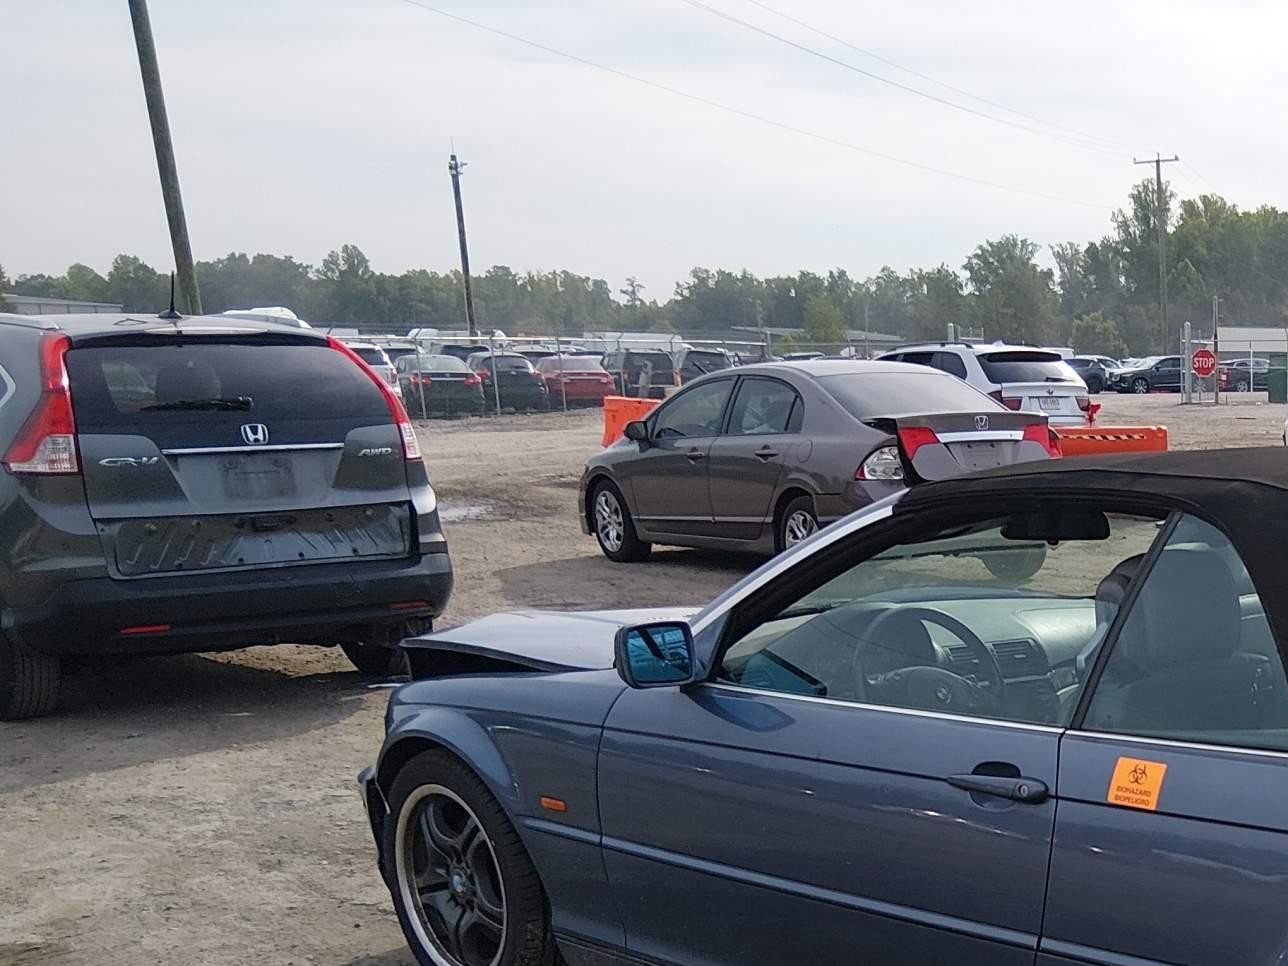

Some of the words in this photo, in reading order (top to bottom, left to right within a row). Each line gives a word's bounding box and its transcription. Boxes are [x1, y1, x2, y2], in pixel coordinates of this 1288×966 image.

[1193, 357, 1215, 369] STOP
[358, 447, 393, 457] AWD
[1116, 785, 1152, 797] BIOHAZARD
